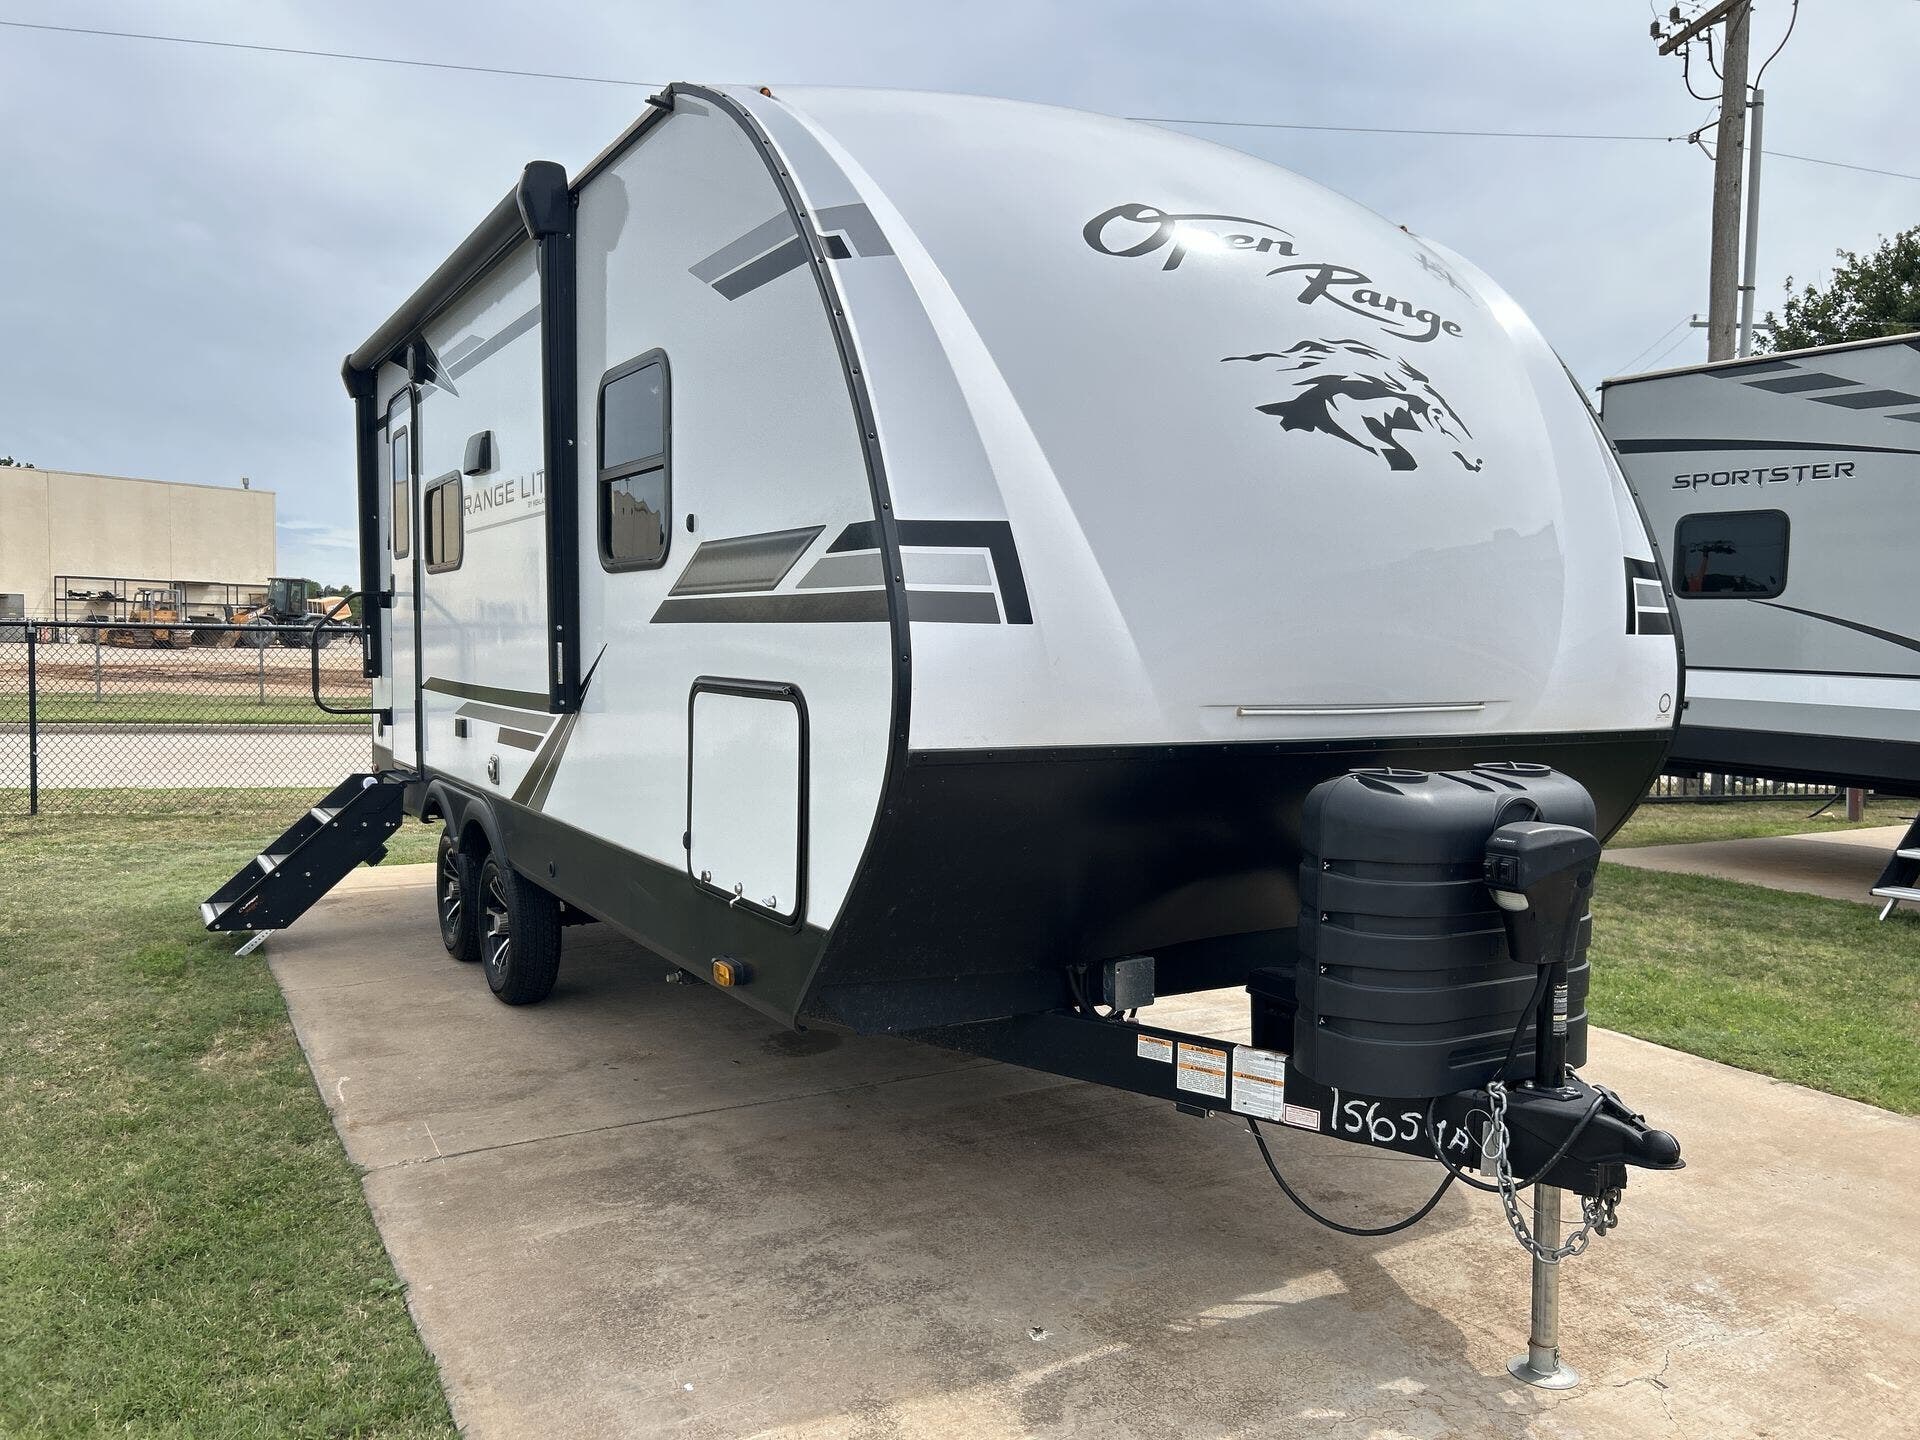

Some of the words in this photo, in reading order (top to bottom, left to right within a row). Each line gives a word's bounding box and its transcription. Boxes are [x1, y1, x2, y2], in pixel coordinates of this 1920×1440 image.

[1083, 203, 1299, 271] Open
[1266, 263, 1463, 343] Range
[464, 480, 514, 516] RANGE
[521, 469, 545, 499] LIT
[1672, 462, 1855, 490] SPORTSTER
